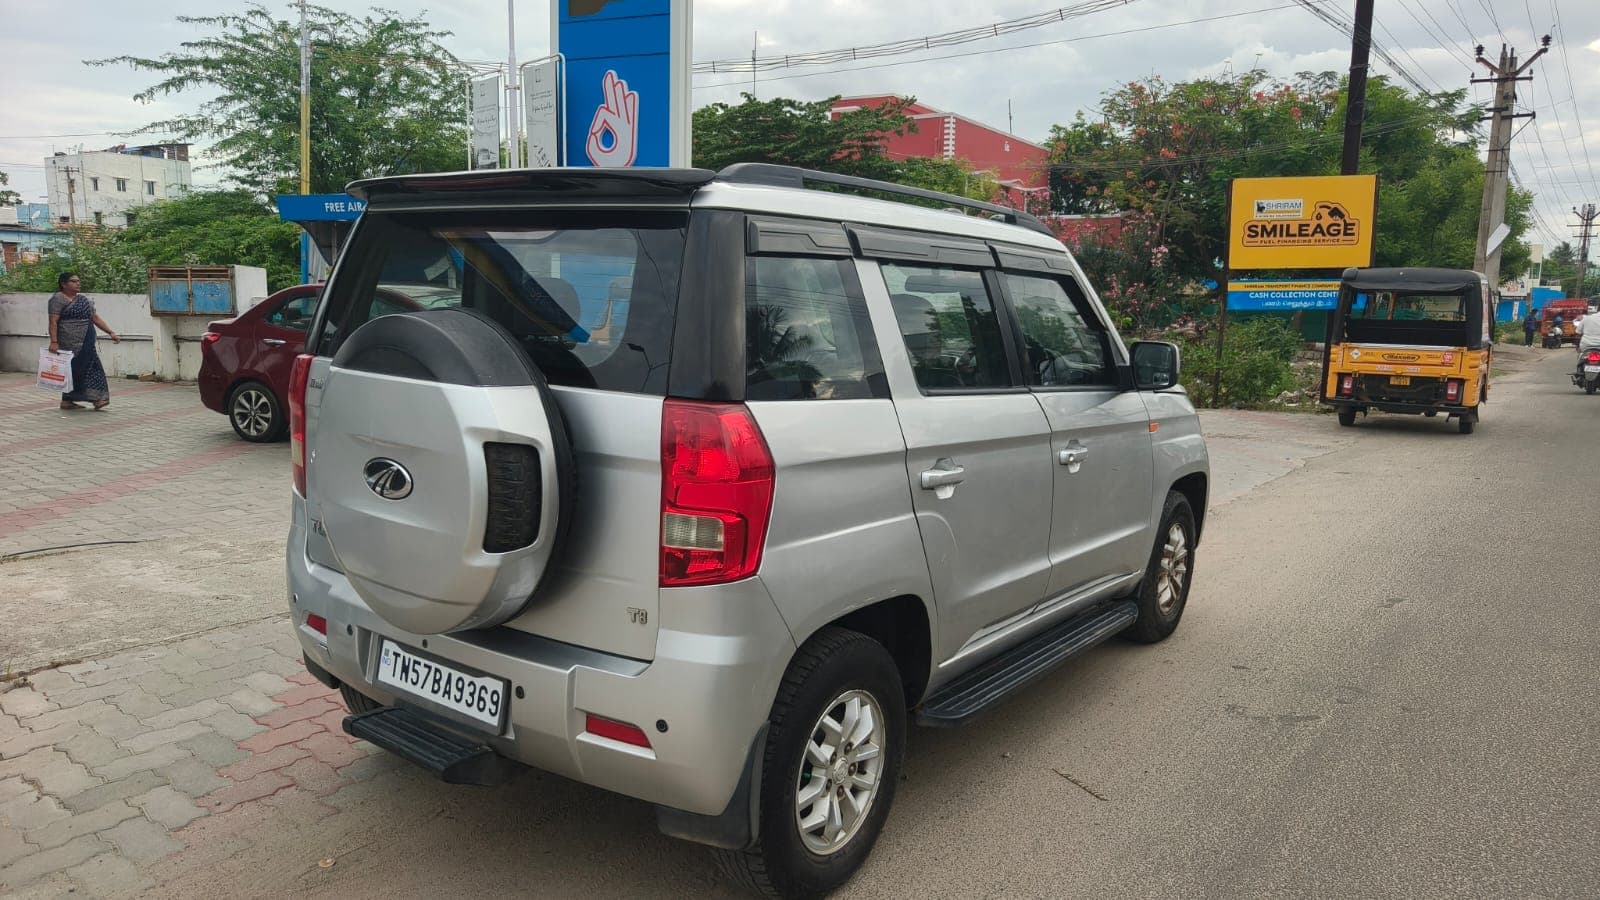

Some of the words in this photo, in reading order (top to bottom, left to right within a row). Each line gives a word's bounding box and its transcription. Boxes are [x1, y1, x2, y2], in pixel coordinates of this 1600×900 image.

[324, 202, 346, 213] FREE
[1265, 202, 1302, 210] SHRIRAM
[1246, 222, 1356, 239] SMILEAGE
[1249, 291, 1269, 299] CASH
[1270, 291, 1316, 299] COLLECTION
[626, 606, 648, 625] T8
[391, 650, 501, 718] TN57BA9369
